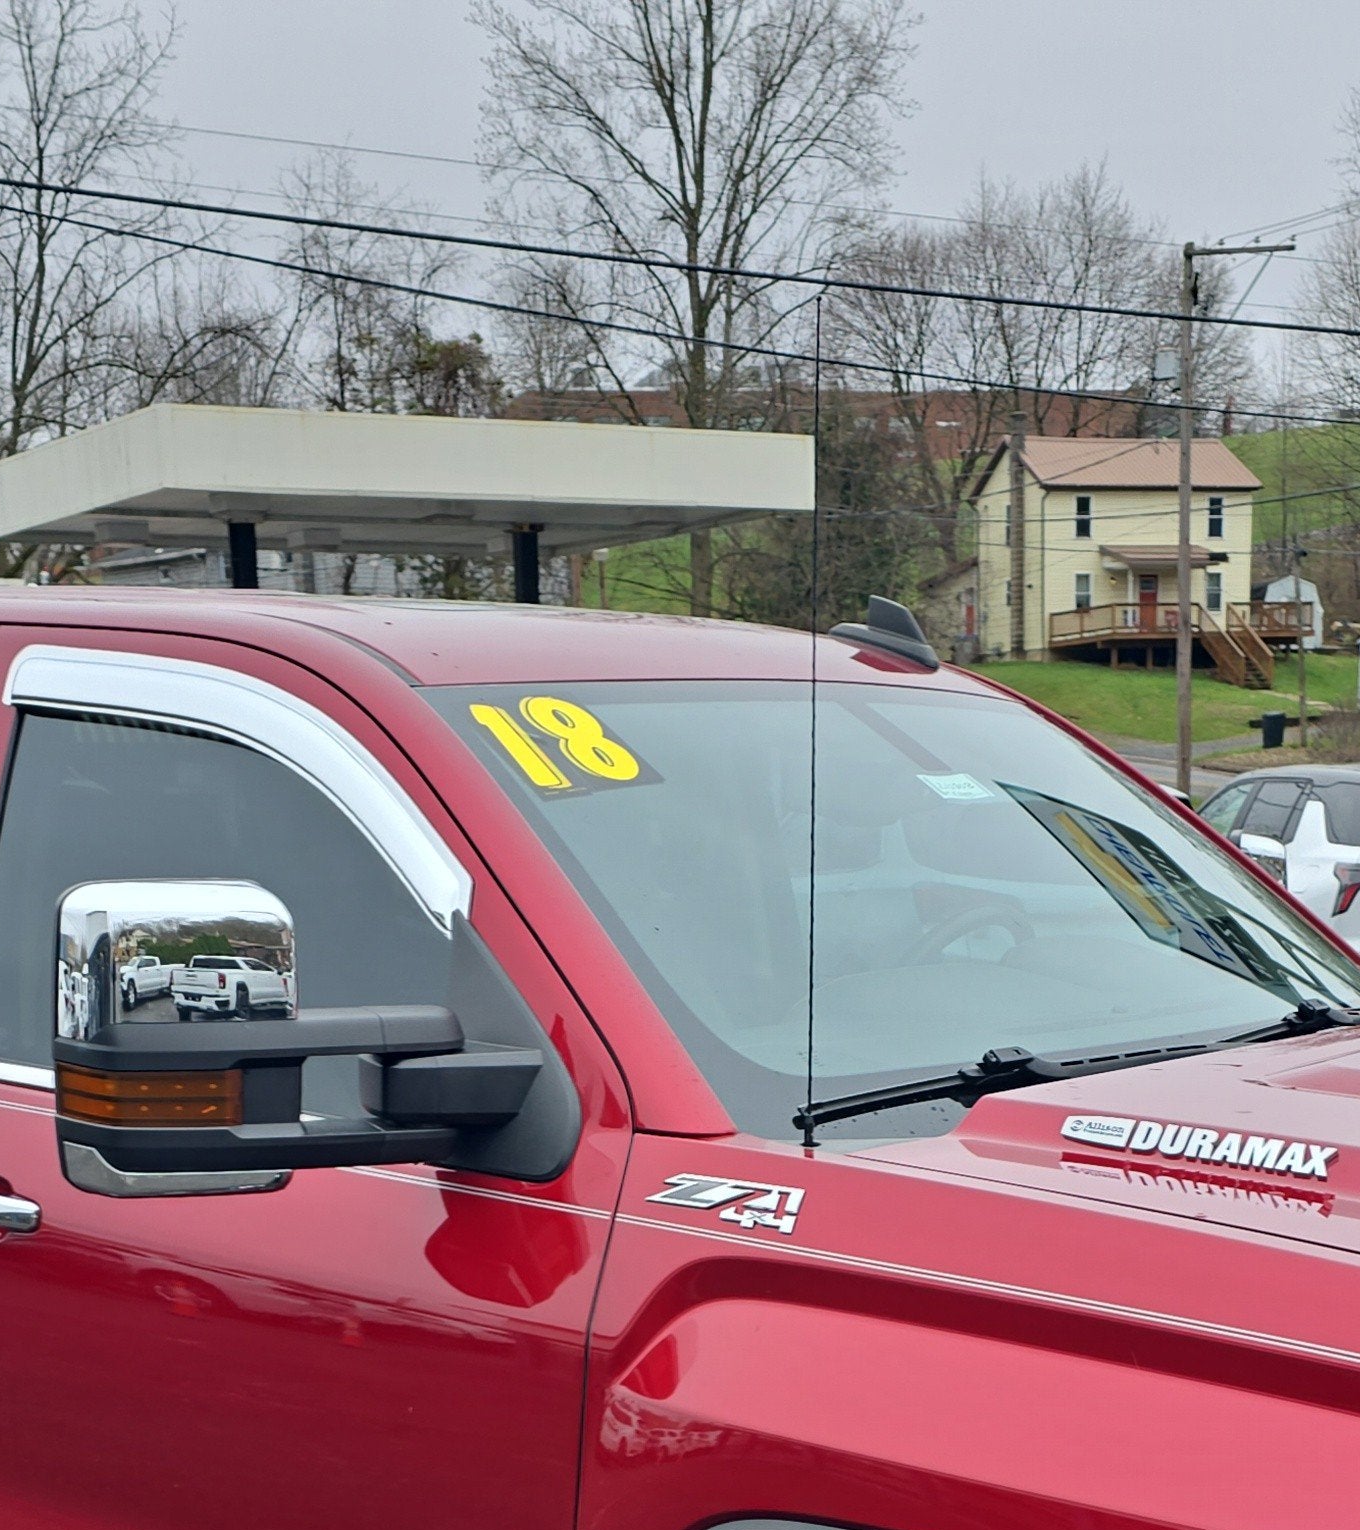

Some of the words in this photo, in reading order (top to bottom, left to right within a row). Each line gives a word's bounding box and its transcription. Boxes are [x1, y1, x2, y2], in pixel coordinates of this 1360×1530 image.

[469, 696, 640, 788] 18
[1085, 1121, 1125, 1133] Allison
[1129, 1119, 1338, 1180] DURAMAX
[645, 1172, 806, 1216] Z71
